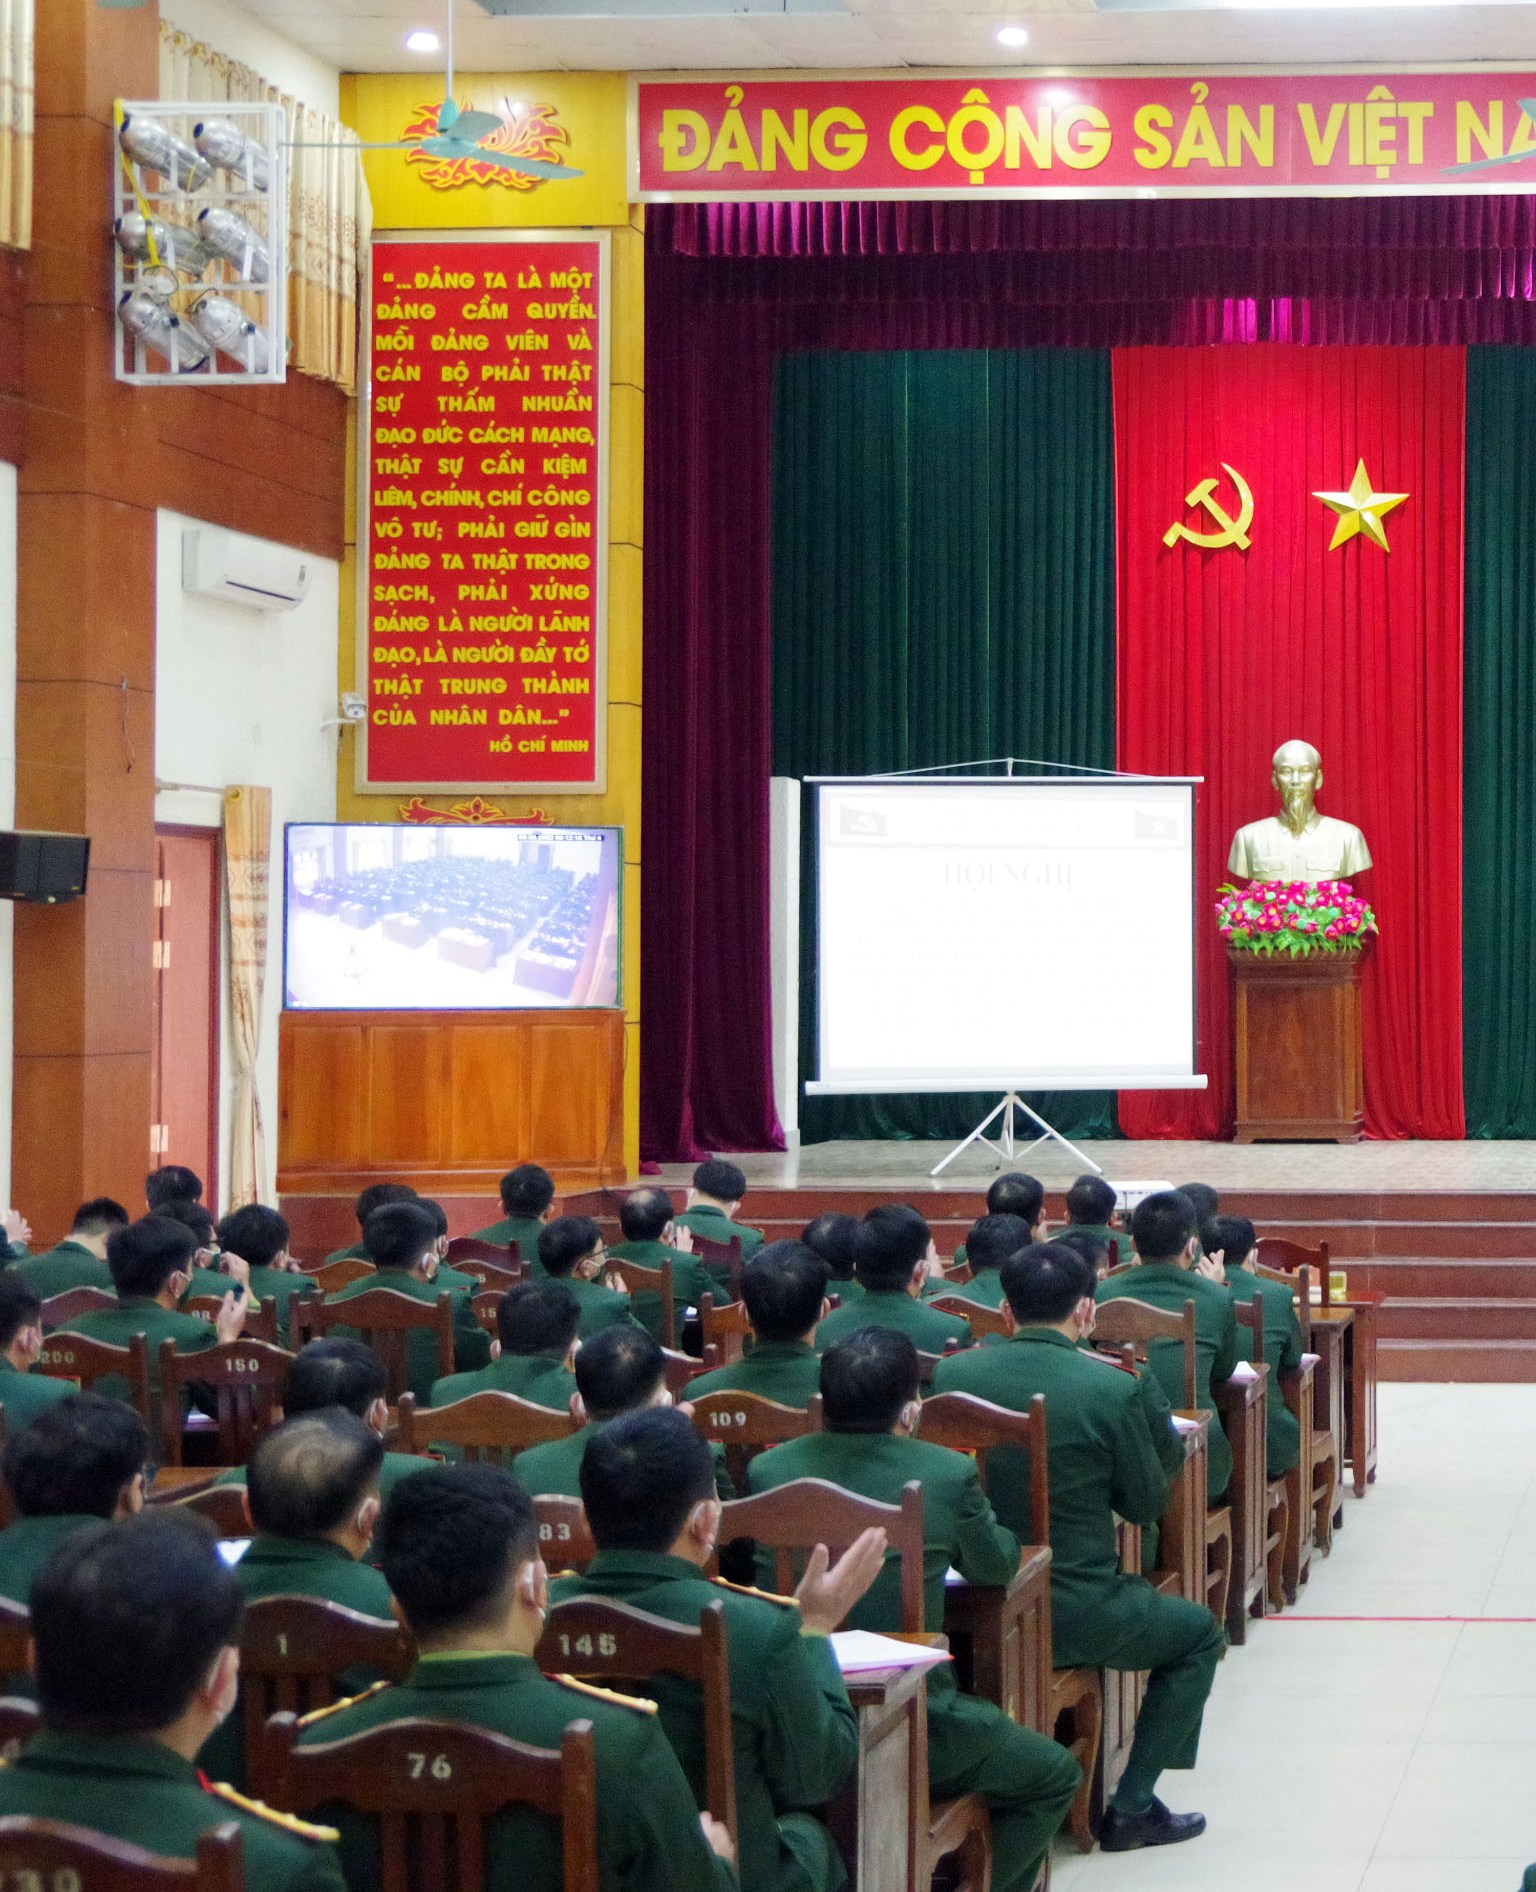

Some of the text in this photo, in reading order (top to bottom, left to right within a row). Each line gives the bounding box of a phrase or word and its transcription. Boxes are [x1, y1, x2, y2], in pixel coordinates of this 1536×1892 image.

[660, 85, 867, 171] ĐẢNG
[889, 88, 1113, 184] CỘNG
[1133, 81, 1274, 169] SẢN
[1297, 85, 1434, 178] VIỆT
[484, 272, 508, 288] TA
[518, 265, 542, 288] LÀ
[551, 266, 592, 293] MỘT
[376, 296, 436, 319] ĐẢNG
[431, 328, 489, 351] ĐẢNG
[506, 329, 548, 350] VIÊN
[567, 327, 592, 350] VÀ
[376, 358, 592, 386] CÁN BỘ PHẢI THẬT
[376, 393, 403, 416] SỰ
[376, 419, 595, 448] ĐẠO ĐỨC CÁCH MẠNG,
[376, 454, 422, 478] THẬT
[439, 457, 463, 478] SỰ
[421, 483, 484, 508] CHÍNH,
[487, 483, 523, 506] CHÍ
[528, 484, 591, 506] CÔNG
[376, 517, 402, 537] VÔ
[412, 521, 442, 540] TƯ;
[458, 515, 504, 538] PHẢI
[555, 515, 590, 538] GÌN
[375, 546, 590, 574] ĐẢNG TA THẬT TRONG
[374, 576, 589, 605] SẠCH, PHẢI XỨNG
[374, 607, 589, 632] ĐÁNG LÀ NGƯỜI LÃNH
[373, 647, 421, 667] ĐẠO,
[424, 640, 448, 662] LÀ
[453, 639, 514, 663] NGƯỜI
[374, 671, 589, 699] THẬT TRUNG THÀNH
[373, 703, 416, 725] CỦA
[430, 705, 487, 725] NHÂN
[518, 735, 546, 752] CHÍ
[551, 740, 589, 752] MINH
[225, 1358, 259, 1372] 150
[407, 1753, 452, 1780] 76
